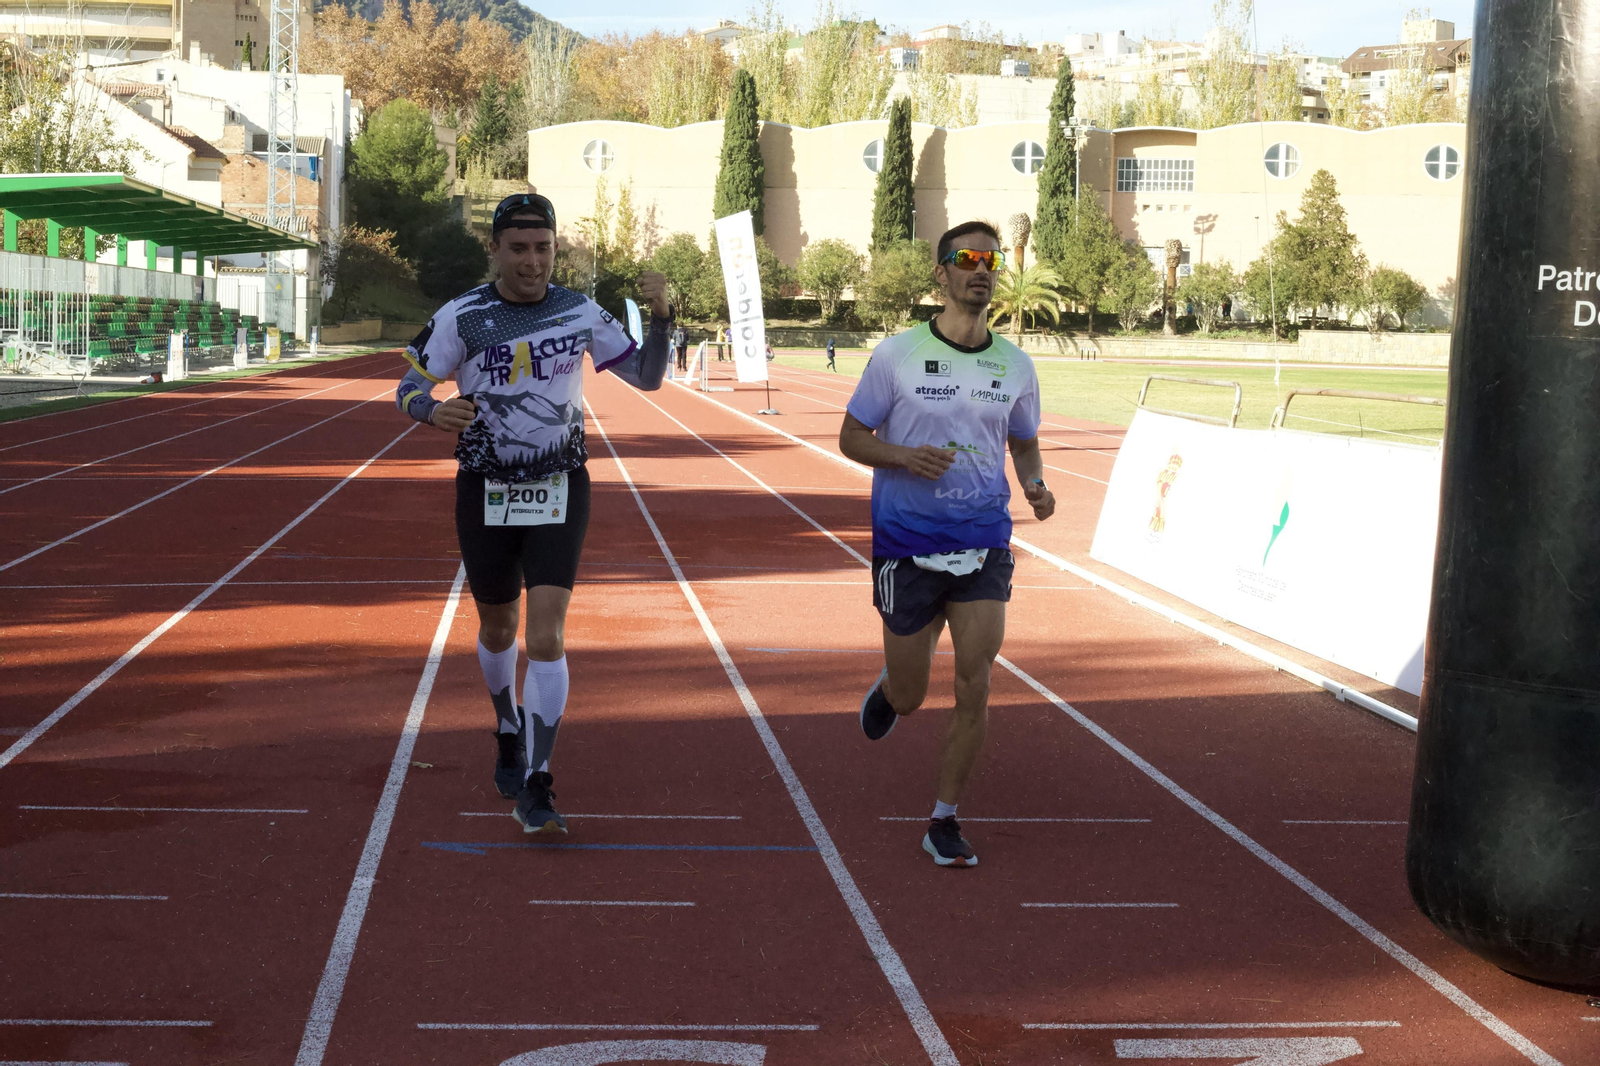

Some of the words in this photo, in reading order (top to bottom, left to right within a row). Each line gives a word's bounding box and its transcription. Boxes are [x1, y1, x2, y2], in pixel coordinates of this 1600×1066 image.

[1537, 264, 1600, 291] Patr
[1573, 300, 1600, 327] D
[477, 336, 579, 373] JABALCUZ
[486, 360, 549, 386] TRAIL
[548, 358, 575, 385] Jaén
[915, 384, 956, 396] atracón
[508, 489, 548, 504] 200
